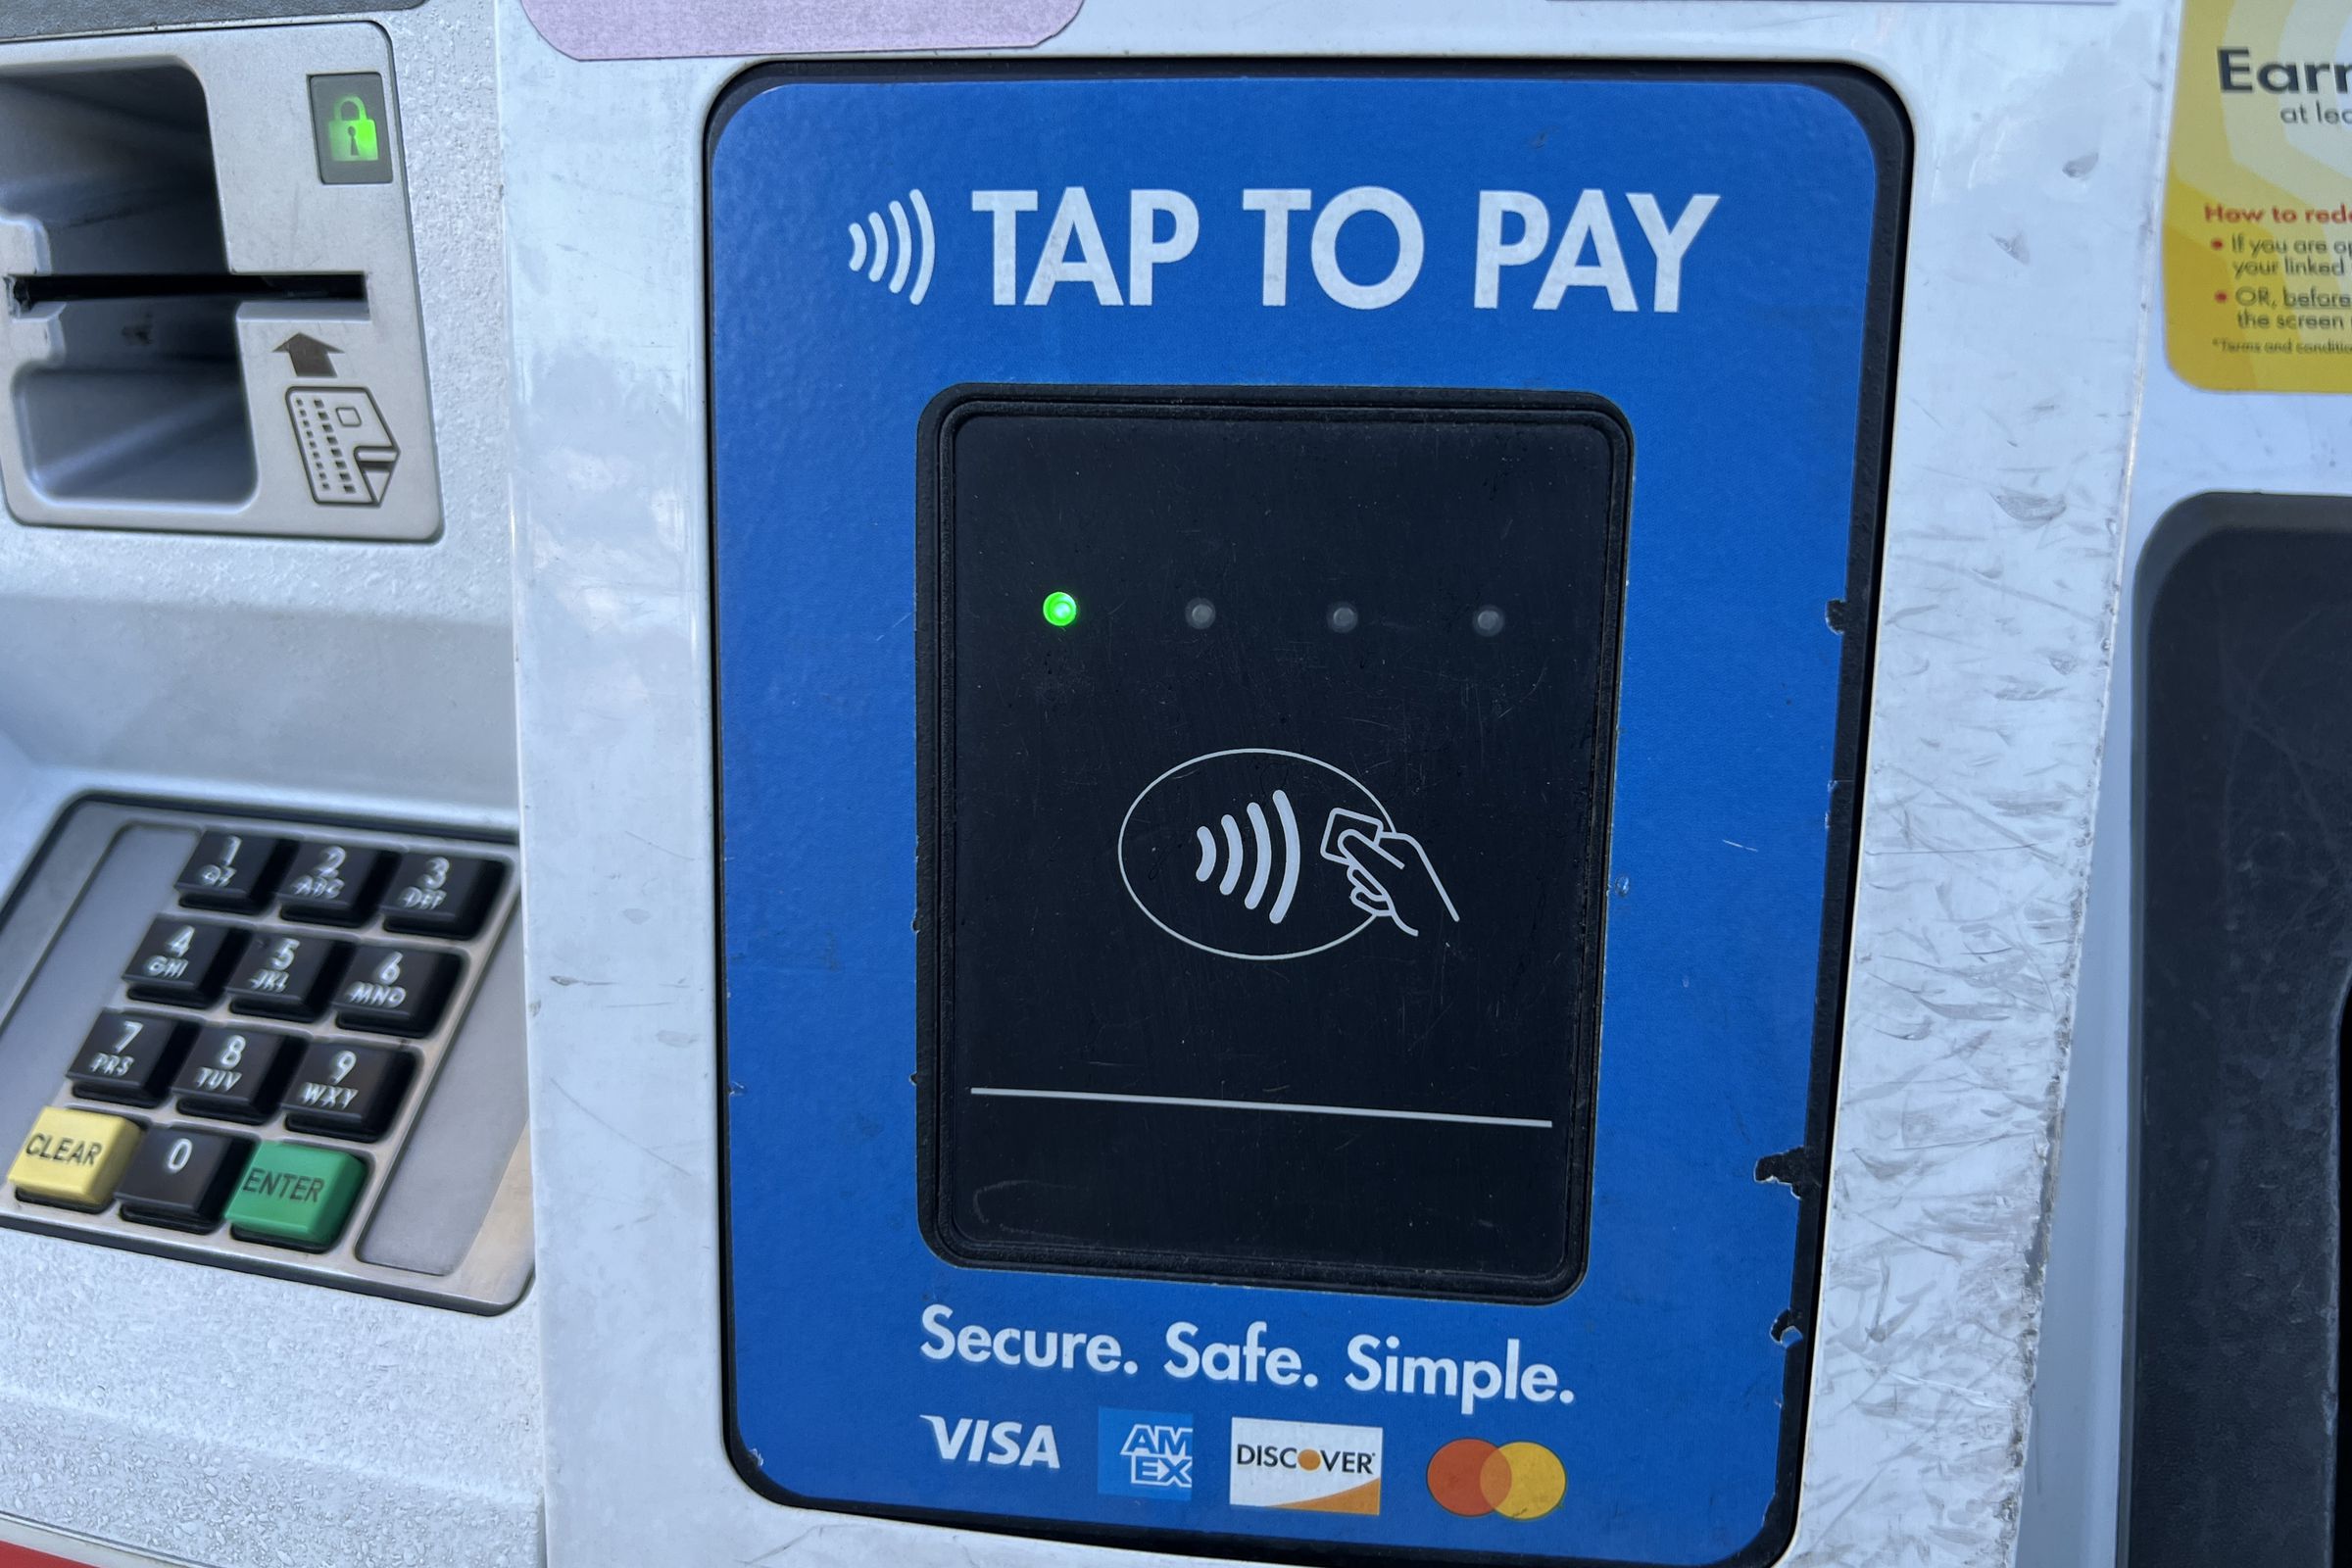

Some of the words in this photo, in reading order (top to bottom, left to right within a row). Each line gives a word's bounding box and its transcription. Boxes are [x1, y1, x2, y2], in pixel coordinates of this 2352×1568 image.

[2279, 104, 2308, 124] at
[2204, 203, 2263, 223] How
[2272, 205, 2297, 223] to
[2305, 202, 2352, 223] red
[971, 186, 1200, 307] TAP
[1243, 185, 1425, 310] TO
[1473, 188, 1721, 313] PAY
[2231, 233, 2244, 253] If
[2250, 239, 2287, 258] you
[2293, 240, 2328, 254] are
[2232, 261, 2278, 280] your
[2283, 255, 2345, 275] linked
[2235, 286, 2277, 310] OR,
[2282, 285, 2352, 310] before
[2237, 308, 2271, 328] the
[2277, 315, 2344, 330] screen
[2264, 338, 2293, 354] and
[221, 836, 241, 866] 1
[314, 846, 346, 878] 2
[419, 857, 450, 889] 3
[294, 875, 344, 900] ABC
[400, 887, 446, 910] DEF
[166, 926, 195, 956] 4
[270, 938, 300, 971] 5
[378, 952, 403, 986] 6
[147, 955, 189, 978] GHI
[250, 969, 291, 993] JKL
[348, 981, 407, 1007] MNO
[114, 1020, 143, 1054] 7
[220, 1035, 247, 1070] 8
[329, 1050, 358, 1084] 9
[88, 1052, 134, 1076] PRS
[196, 1066, 242, 1091] TUV
[303, 1081, 359, 1108] WXY
[25, 1133, 103, 1166] CLEAR
[242, 1169, 324, 1203] ENTER
[920, 1303, 1138, 1375] Secure.
[1164, 1321, 1319, 1388] Safe.
[1345, 1334, 1575, 1415] Simple.
[919, 1414, 1060, 1469] VISA
[1236, 1444, 1374, 1474] DISCOVER
